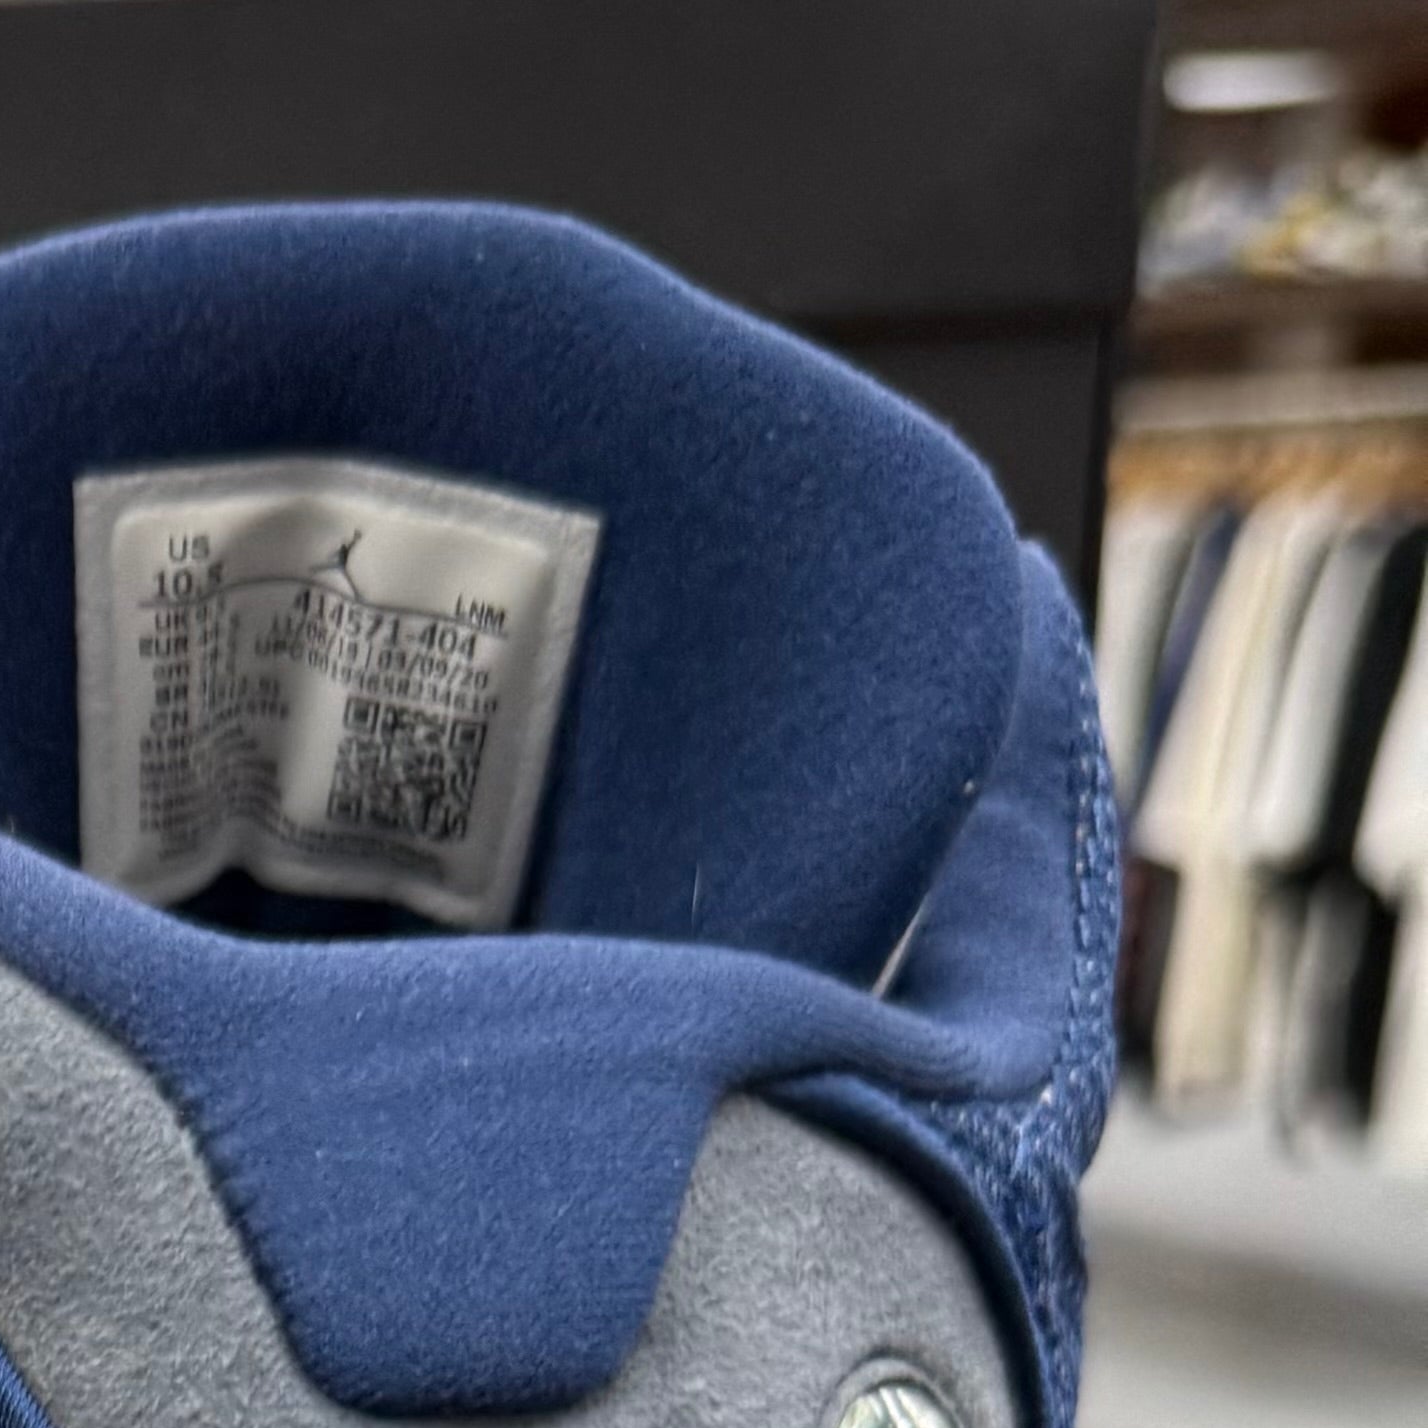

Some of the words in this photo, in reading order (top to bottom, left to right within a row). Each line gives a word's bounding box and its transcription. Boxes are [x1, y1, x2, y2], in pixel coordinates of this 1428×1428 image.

[168, 534, 210, 562] US
[294, 588, 477, 658] 414571-404
[455, 592, 506, 632] LNM
